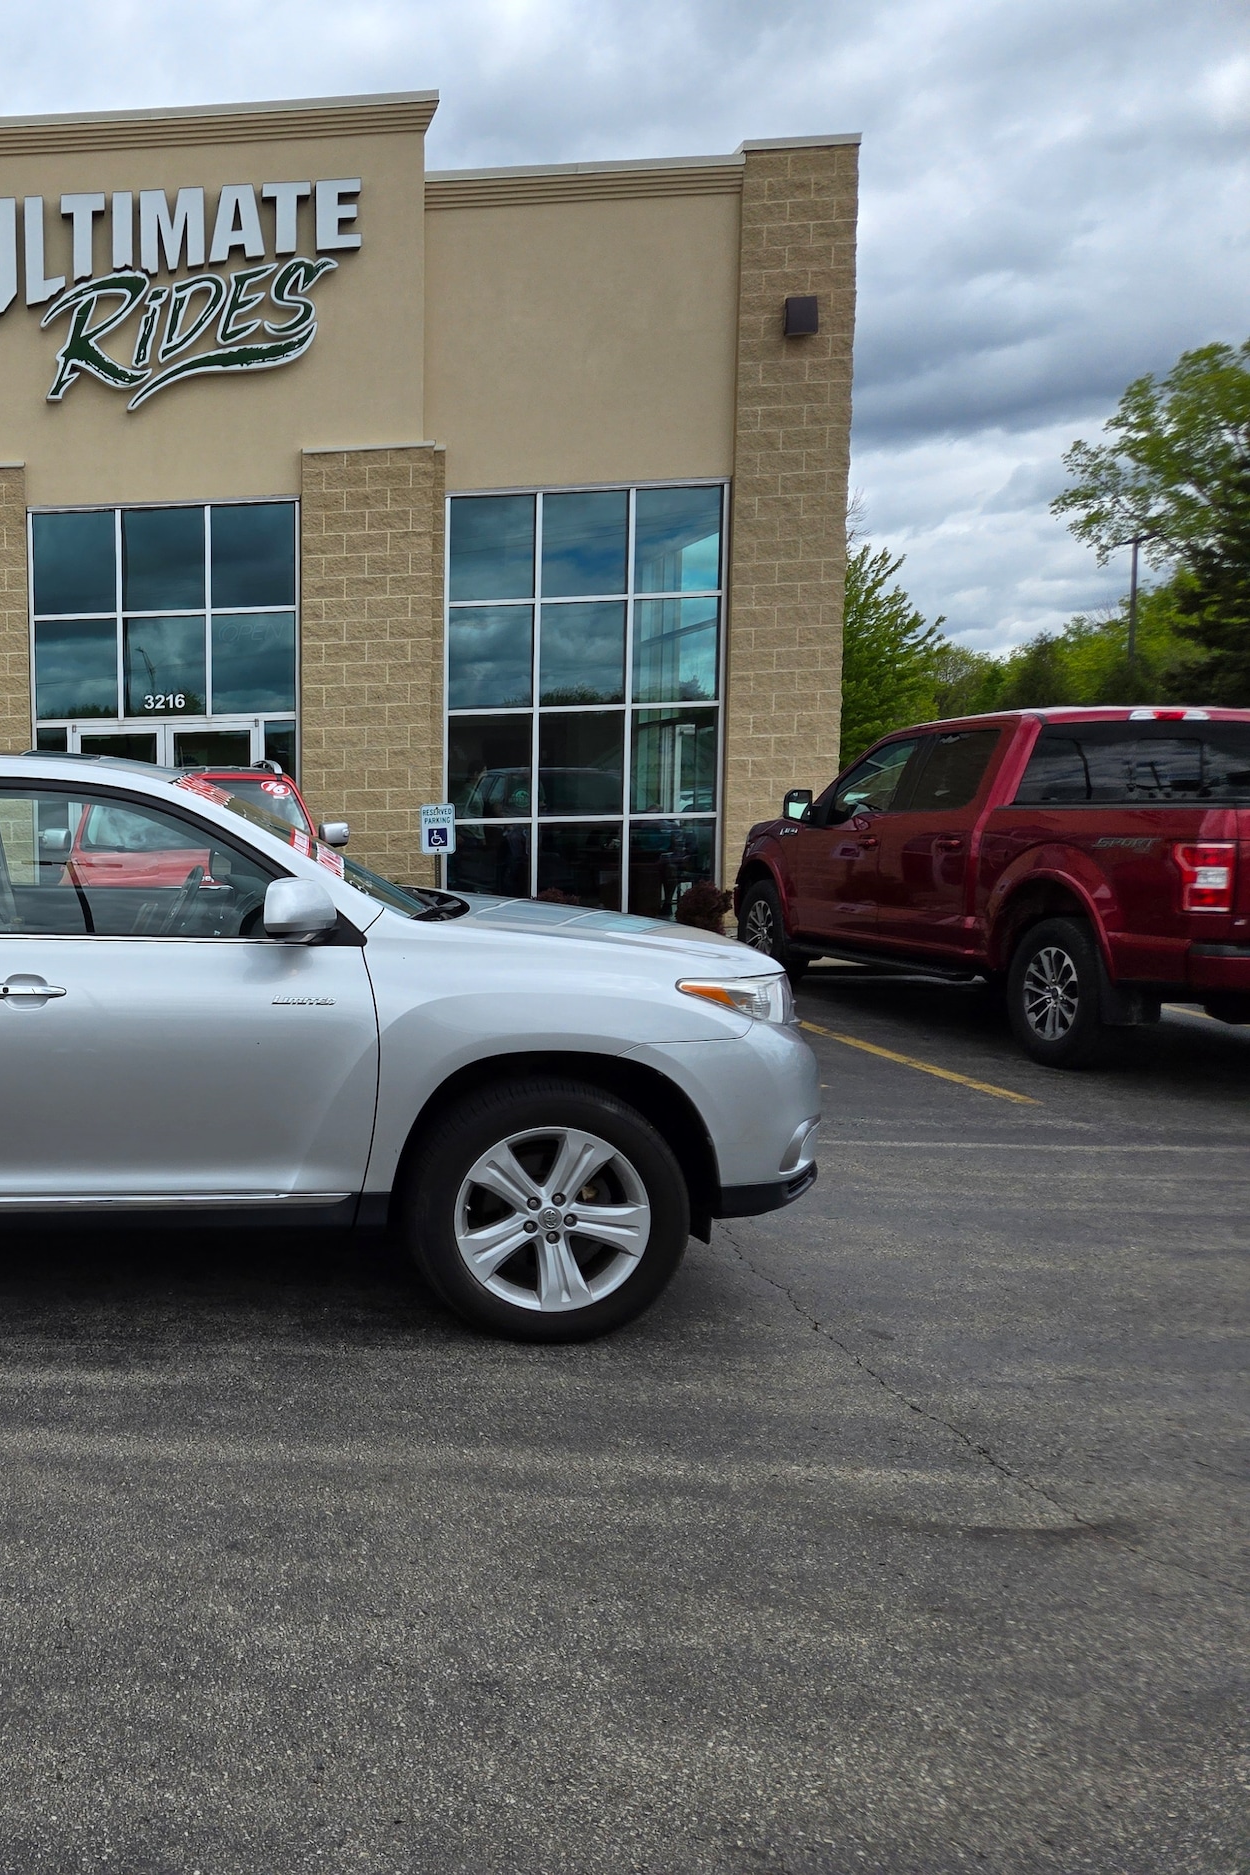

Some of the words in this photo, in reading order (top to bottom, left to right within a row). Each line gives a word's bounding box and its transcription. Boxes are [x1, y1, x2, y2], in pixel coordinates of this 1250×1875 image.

[143, 693, 186, 710] 3216
[265, 782, 286, 794] 16
[422, 808, 452, 816] RESERVED
[424, 816, 451, 825] PARKING
[1092, 837, 1161, 850] SPORT
